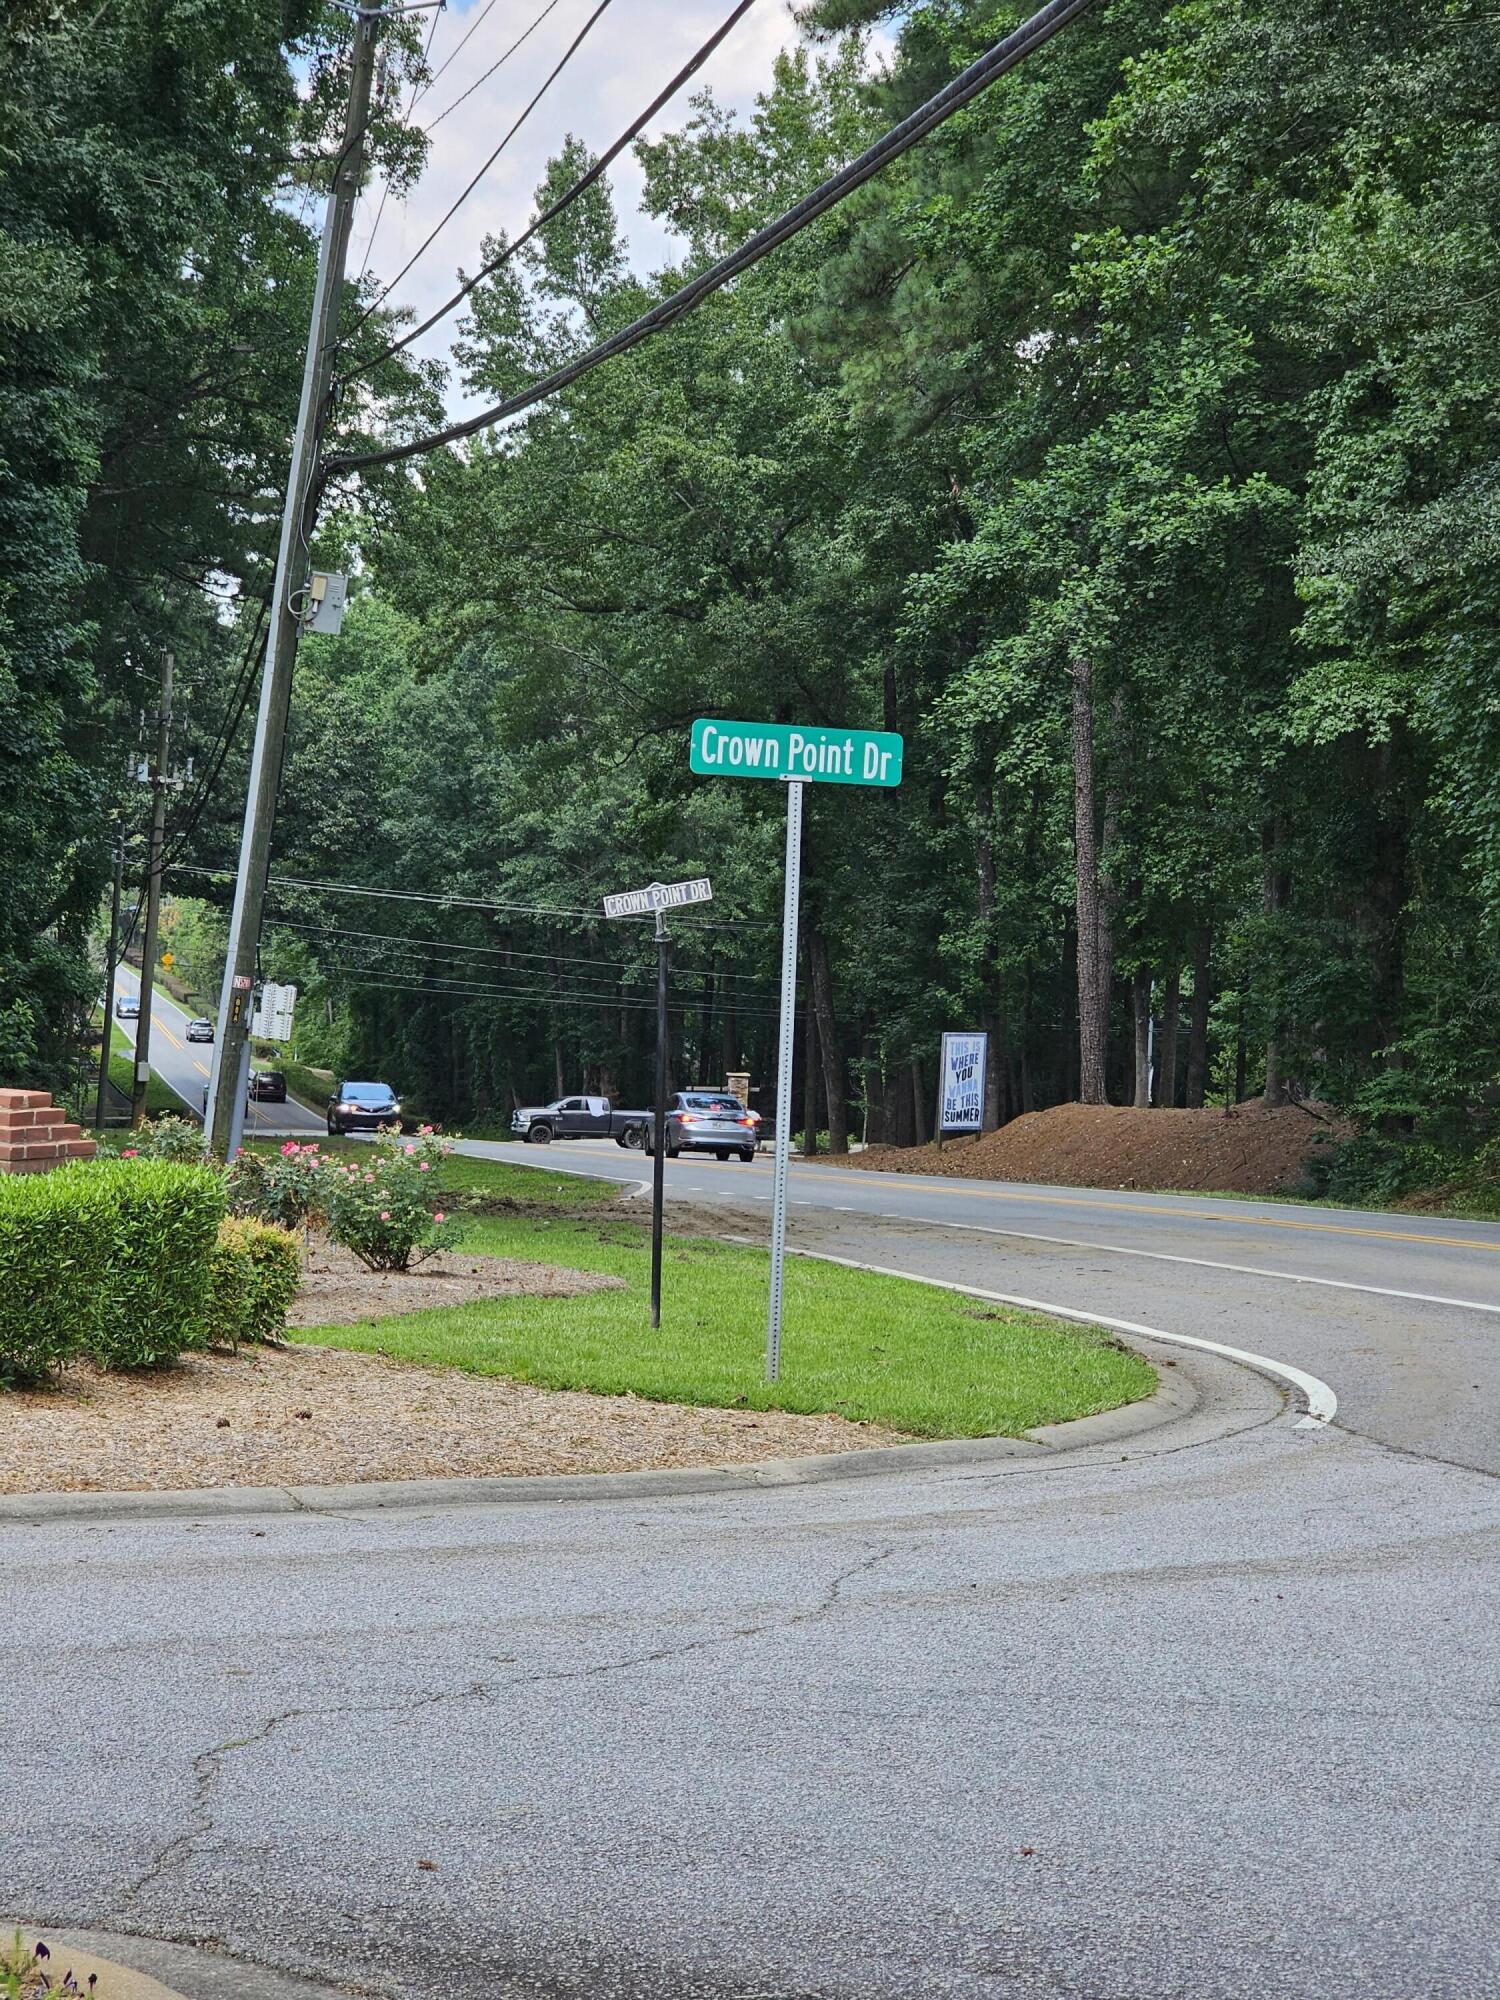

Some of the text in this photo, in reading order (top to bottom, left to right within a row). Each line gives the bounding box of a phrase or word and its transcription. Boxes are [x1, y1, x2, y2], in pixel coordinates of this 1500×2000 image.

[701, 726, 893, 781] Crown Point Dr
[607, 893, 649, 915] CROWN
[652, 885, 687, 907] POINT
[951, 1042, 980, 1055] THIS IS
[951, 1053, 978, 1070] WHERE
[956, 1066, 972, 1083] YOU
[949, 1079, 977, 1097] WANNA
[947, 1094, 978, 1110] BE THIS
[945, 1108, 979, 1122] SUMMER
